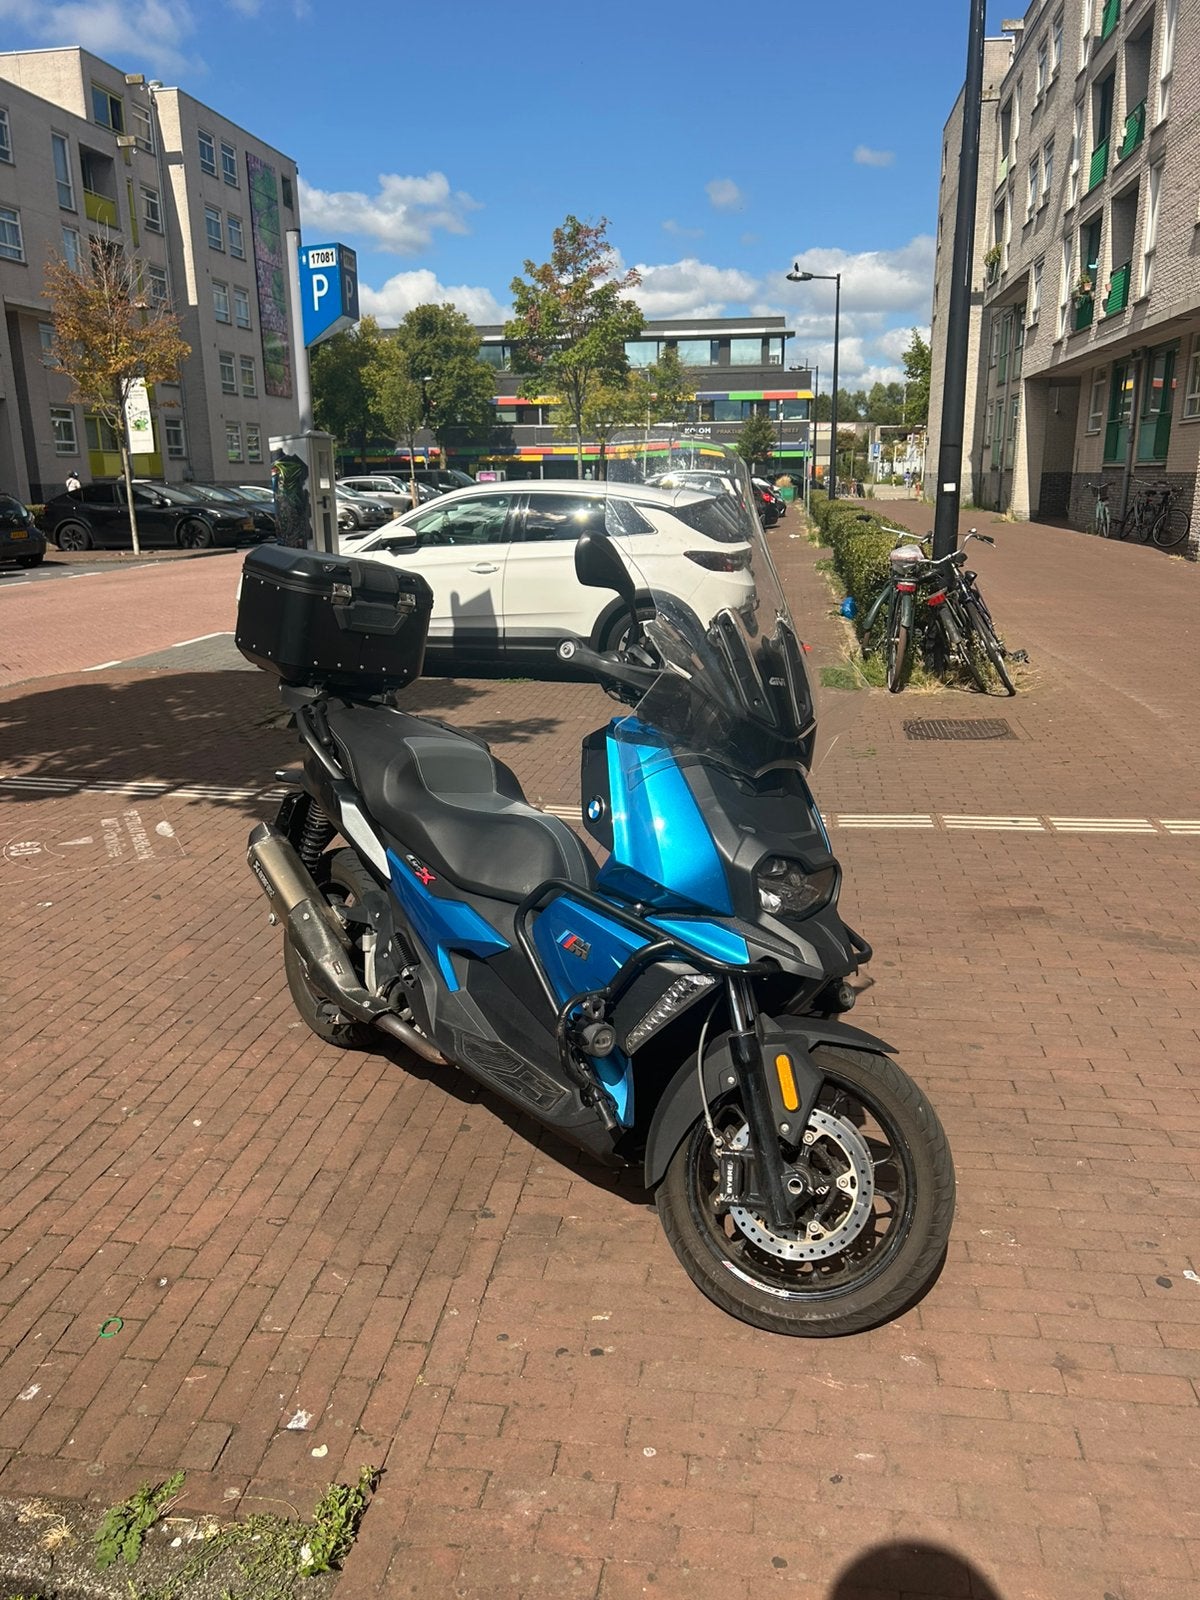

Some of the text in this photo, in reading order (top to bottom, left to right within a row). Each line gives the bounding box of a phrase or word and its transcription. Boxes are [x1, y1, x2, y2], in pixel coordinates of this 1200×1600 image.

[311, 251, 334, 264] 17081
[312, 274, 329, 311] P
[345, 275, 354, 311] P
